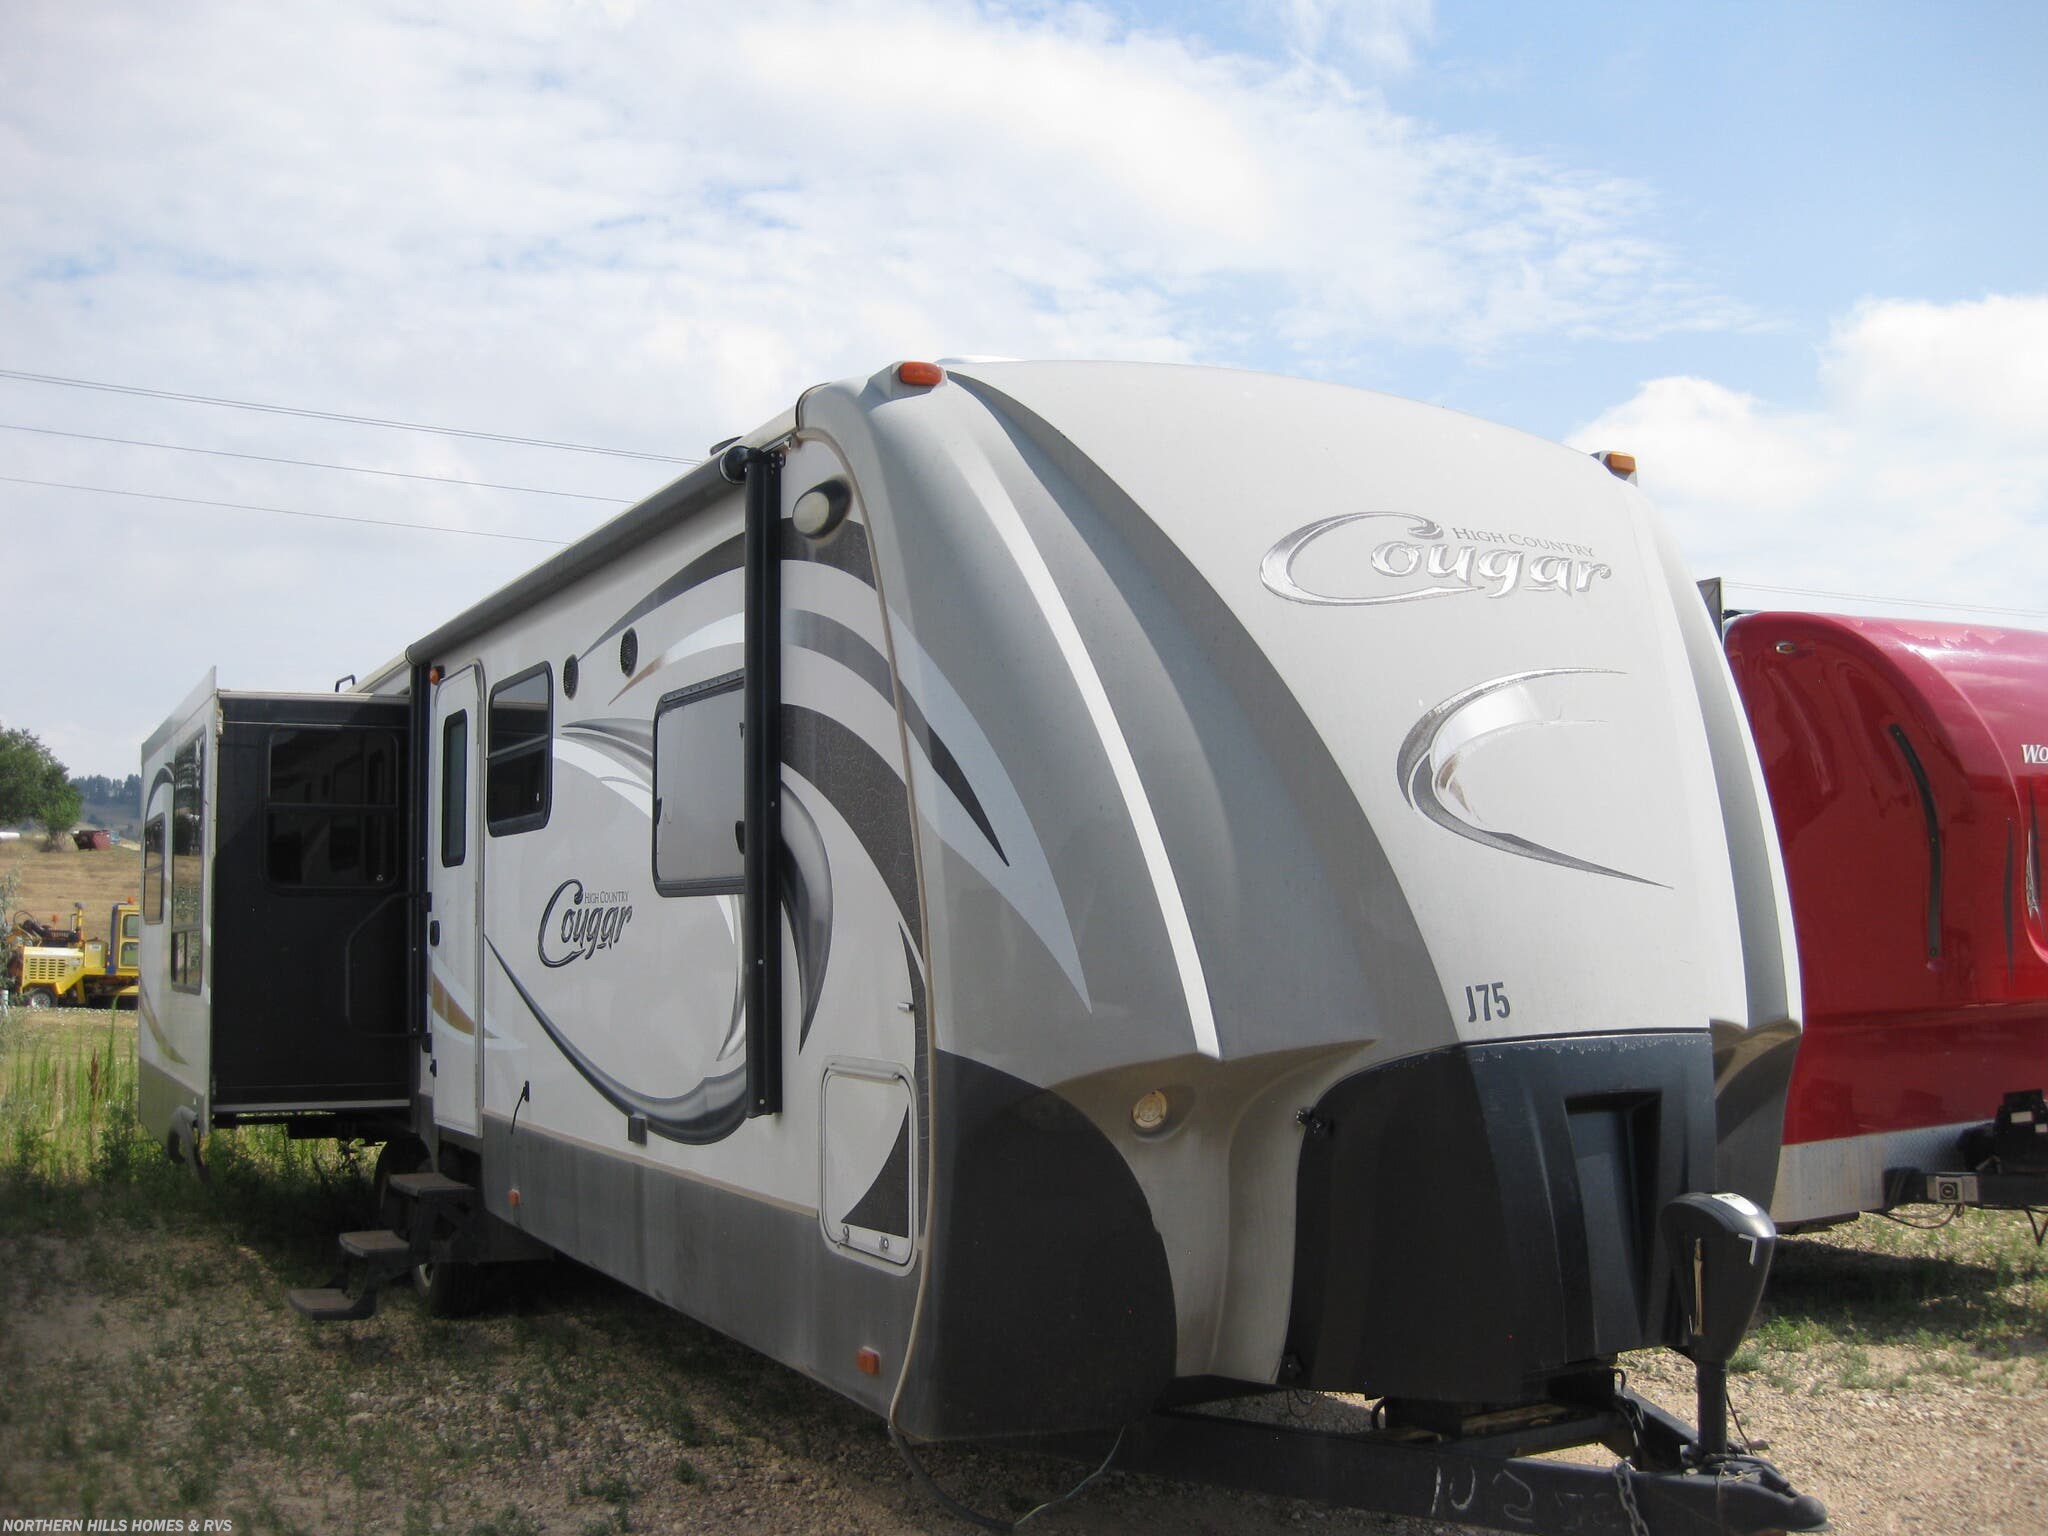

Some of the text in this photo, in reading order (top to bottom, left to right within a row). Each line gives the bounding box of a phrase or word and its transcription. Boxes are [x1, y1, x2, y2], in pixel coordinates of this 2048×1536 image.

[1259, 511, 1612, 607] Cougar
[1452, 527, 1595, 558] HIGH COUNTRY
[584, 890, 630, 904] HIGH COUNTRY
[538, 879, 633, 968] Cougar
[1465, 981, 1511, 1023] J75
